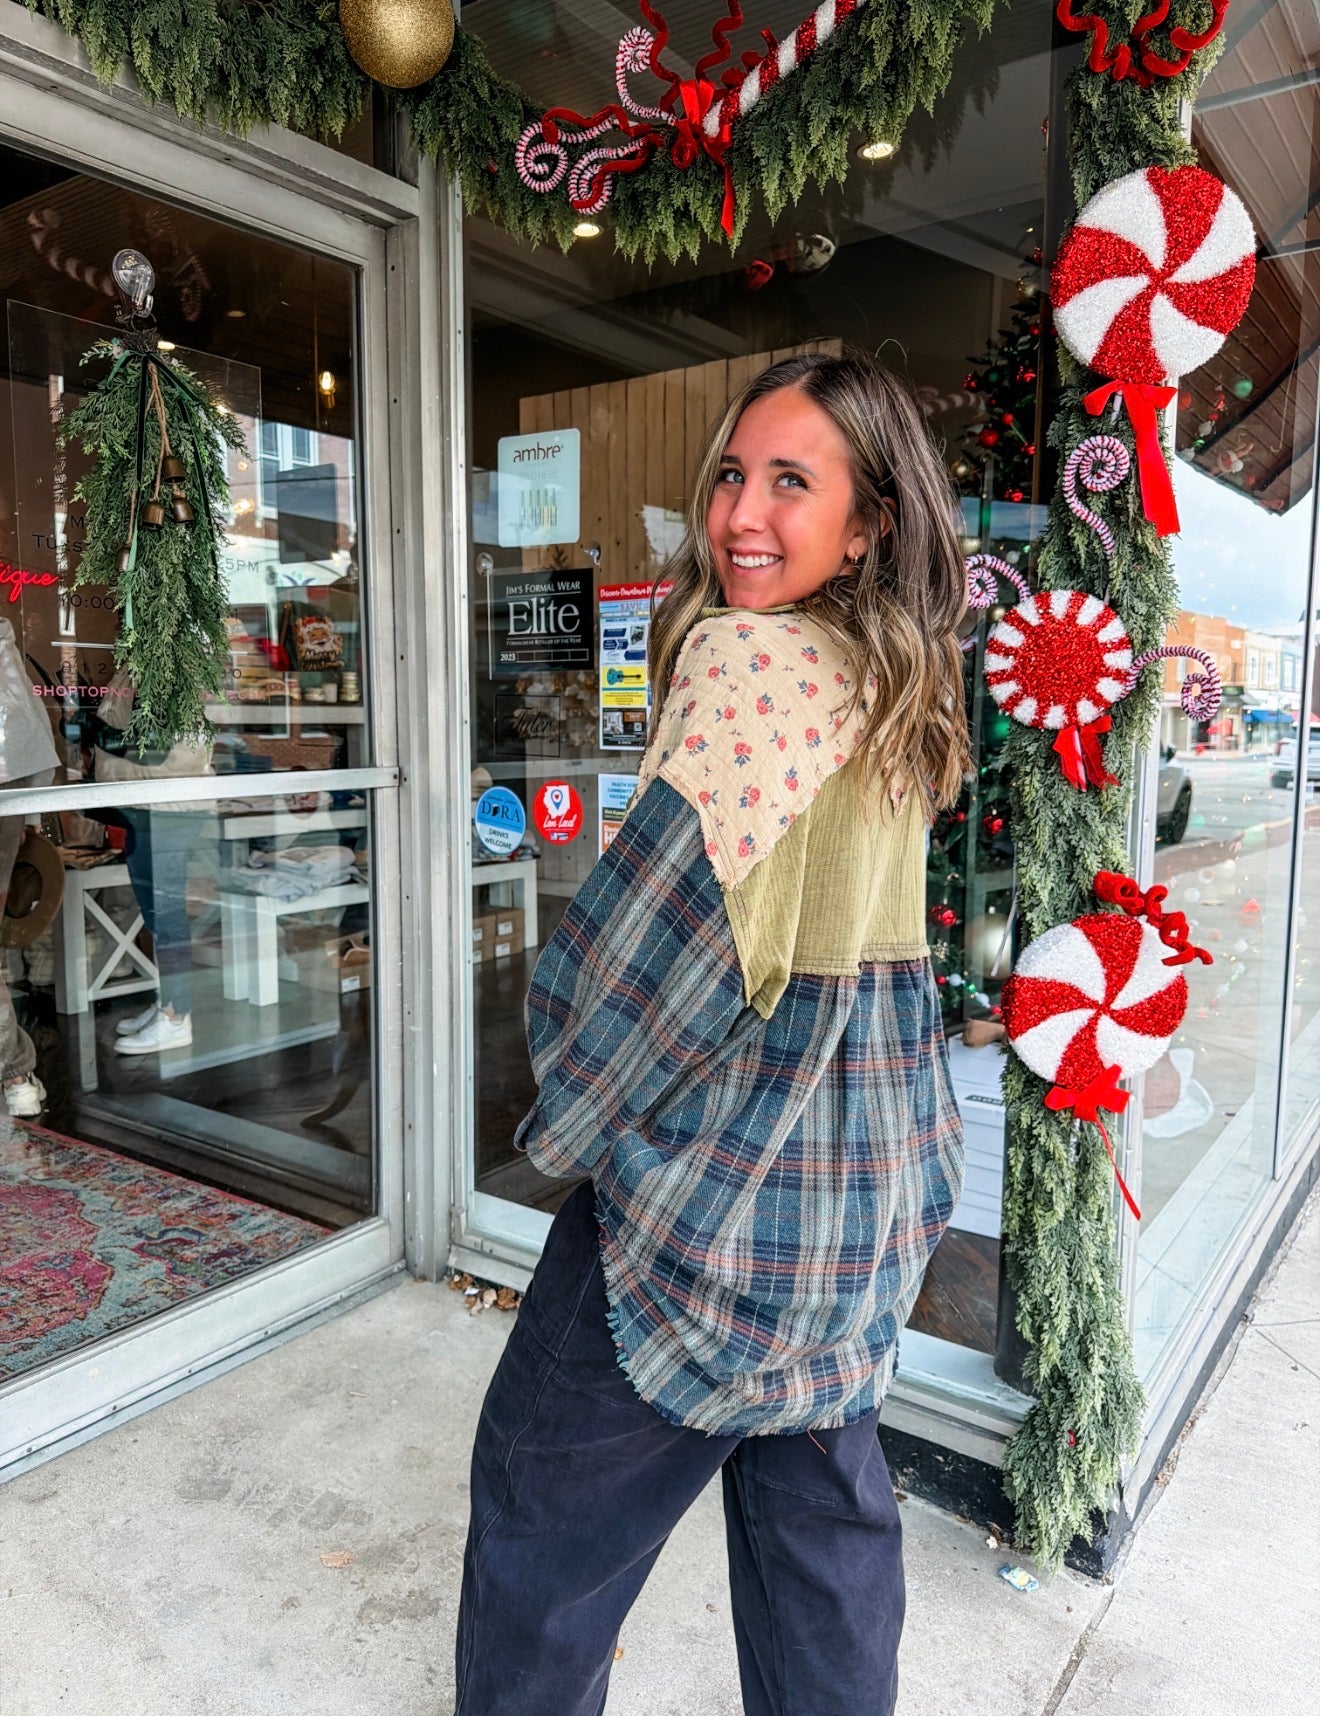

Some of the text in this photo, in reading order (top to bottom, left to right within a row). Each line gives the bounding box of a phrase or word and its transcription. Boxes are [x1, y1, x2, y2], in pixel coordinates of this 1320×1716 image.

[513, 441, 561, 463] ambre
[506, 580, 581, 596] JIM'S FORMAL WEAR
[507, 597, 580, 636] Elite
[500, 653, 516, 662] 2023
[488, 828, 510, 839] DRINKS
[484, 838, 512, 850] WELCOME
